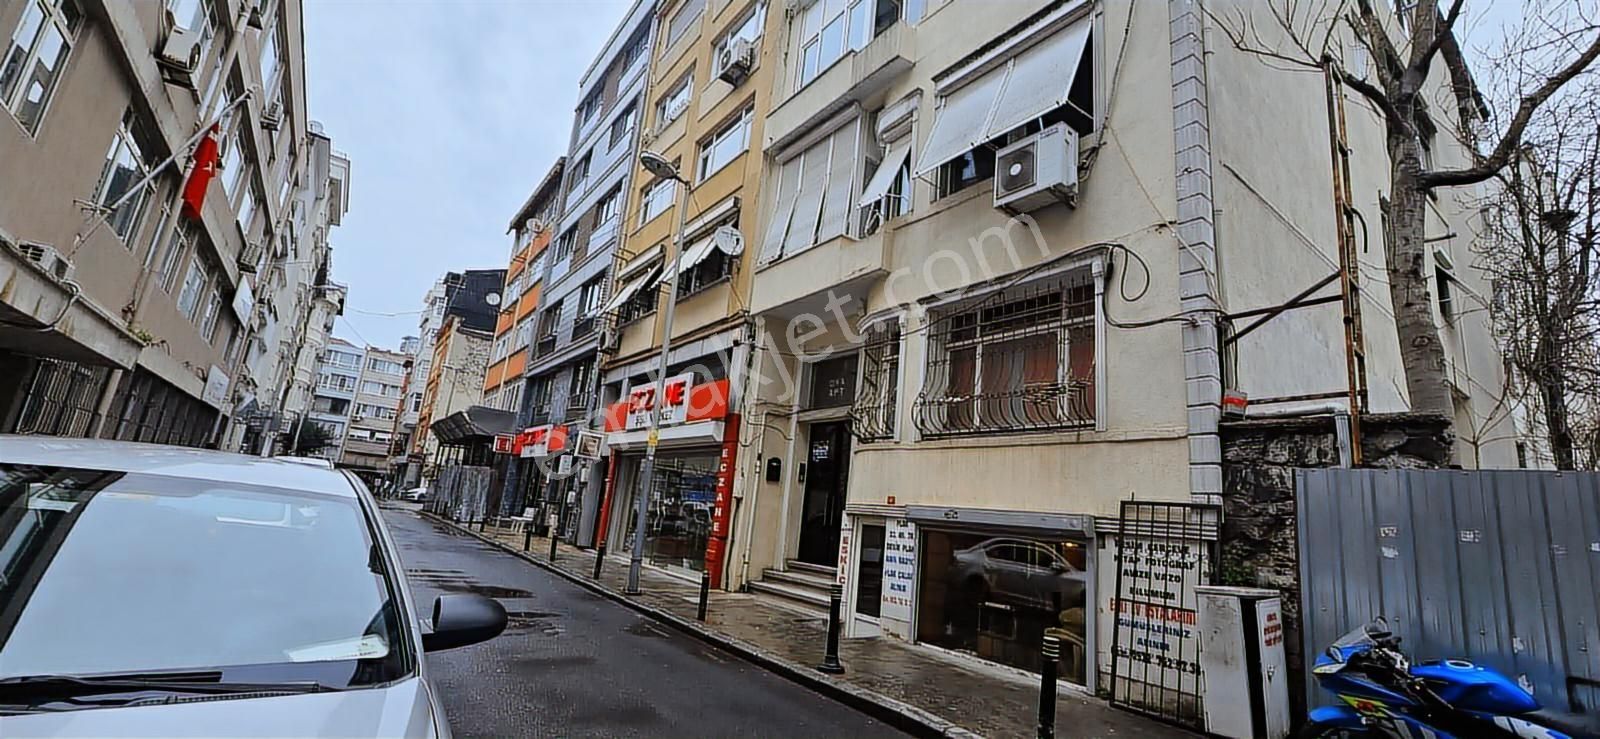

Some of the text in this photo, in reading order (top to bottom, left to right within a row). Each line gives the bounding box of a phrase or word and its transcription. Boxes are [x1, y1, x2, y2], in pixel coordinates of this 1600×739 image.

[629, 381, 687, 414] ECZNE
[713, 448, 729, 532] ECZANE
[1123, 569, 1181, 583] AVZE VAZO
